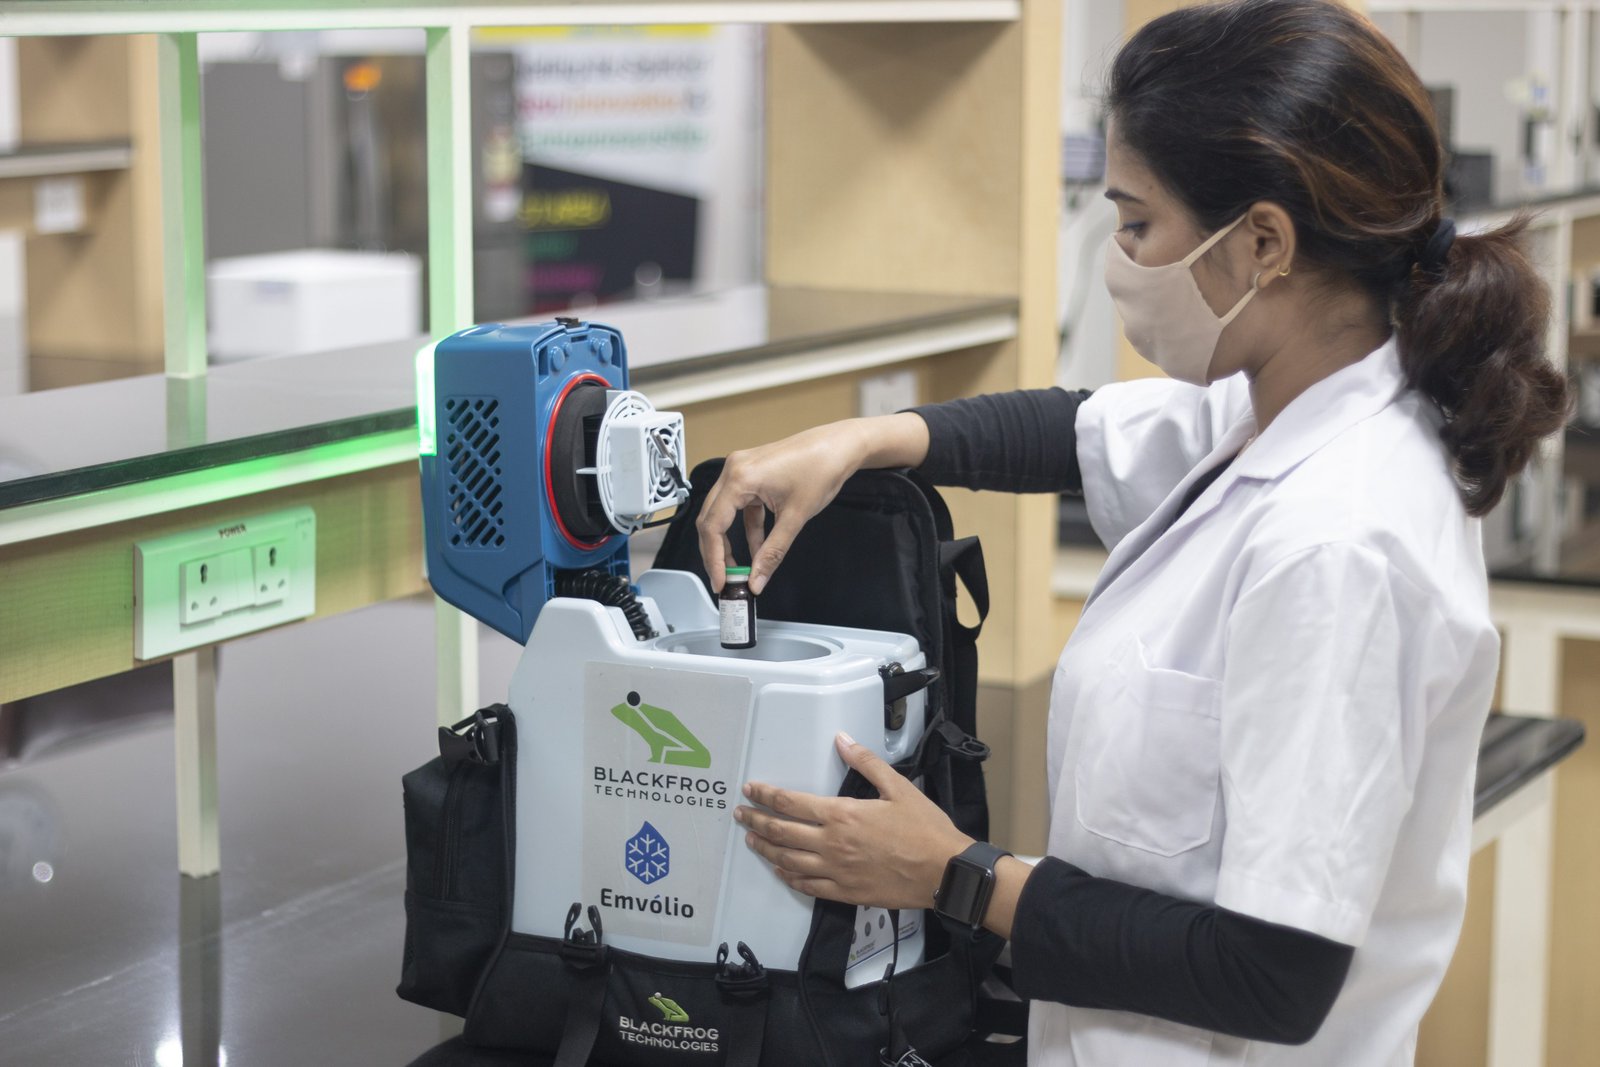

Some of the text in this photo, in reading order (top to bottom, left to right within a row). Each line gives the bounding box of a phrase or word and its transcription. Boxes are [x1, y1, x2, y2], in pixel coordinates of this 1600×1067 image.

[594, 766, 727, 795] BLACKFROG
[594, 784, 727, 809] TECHNOLOGIES
[600, 888, 694, 918] Emvólio
[619, 1016, 719, 1040] BLACKFROG
[619, 1030, 719, 1052] TECHNOLOGIES
